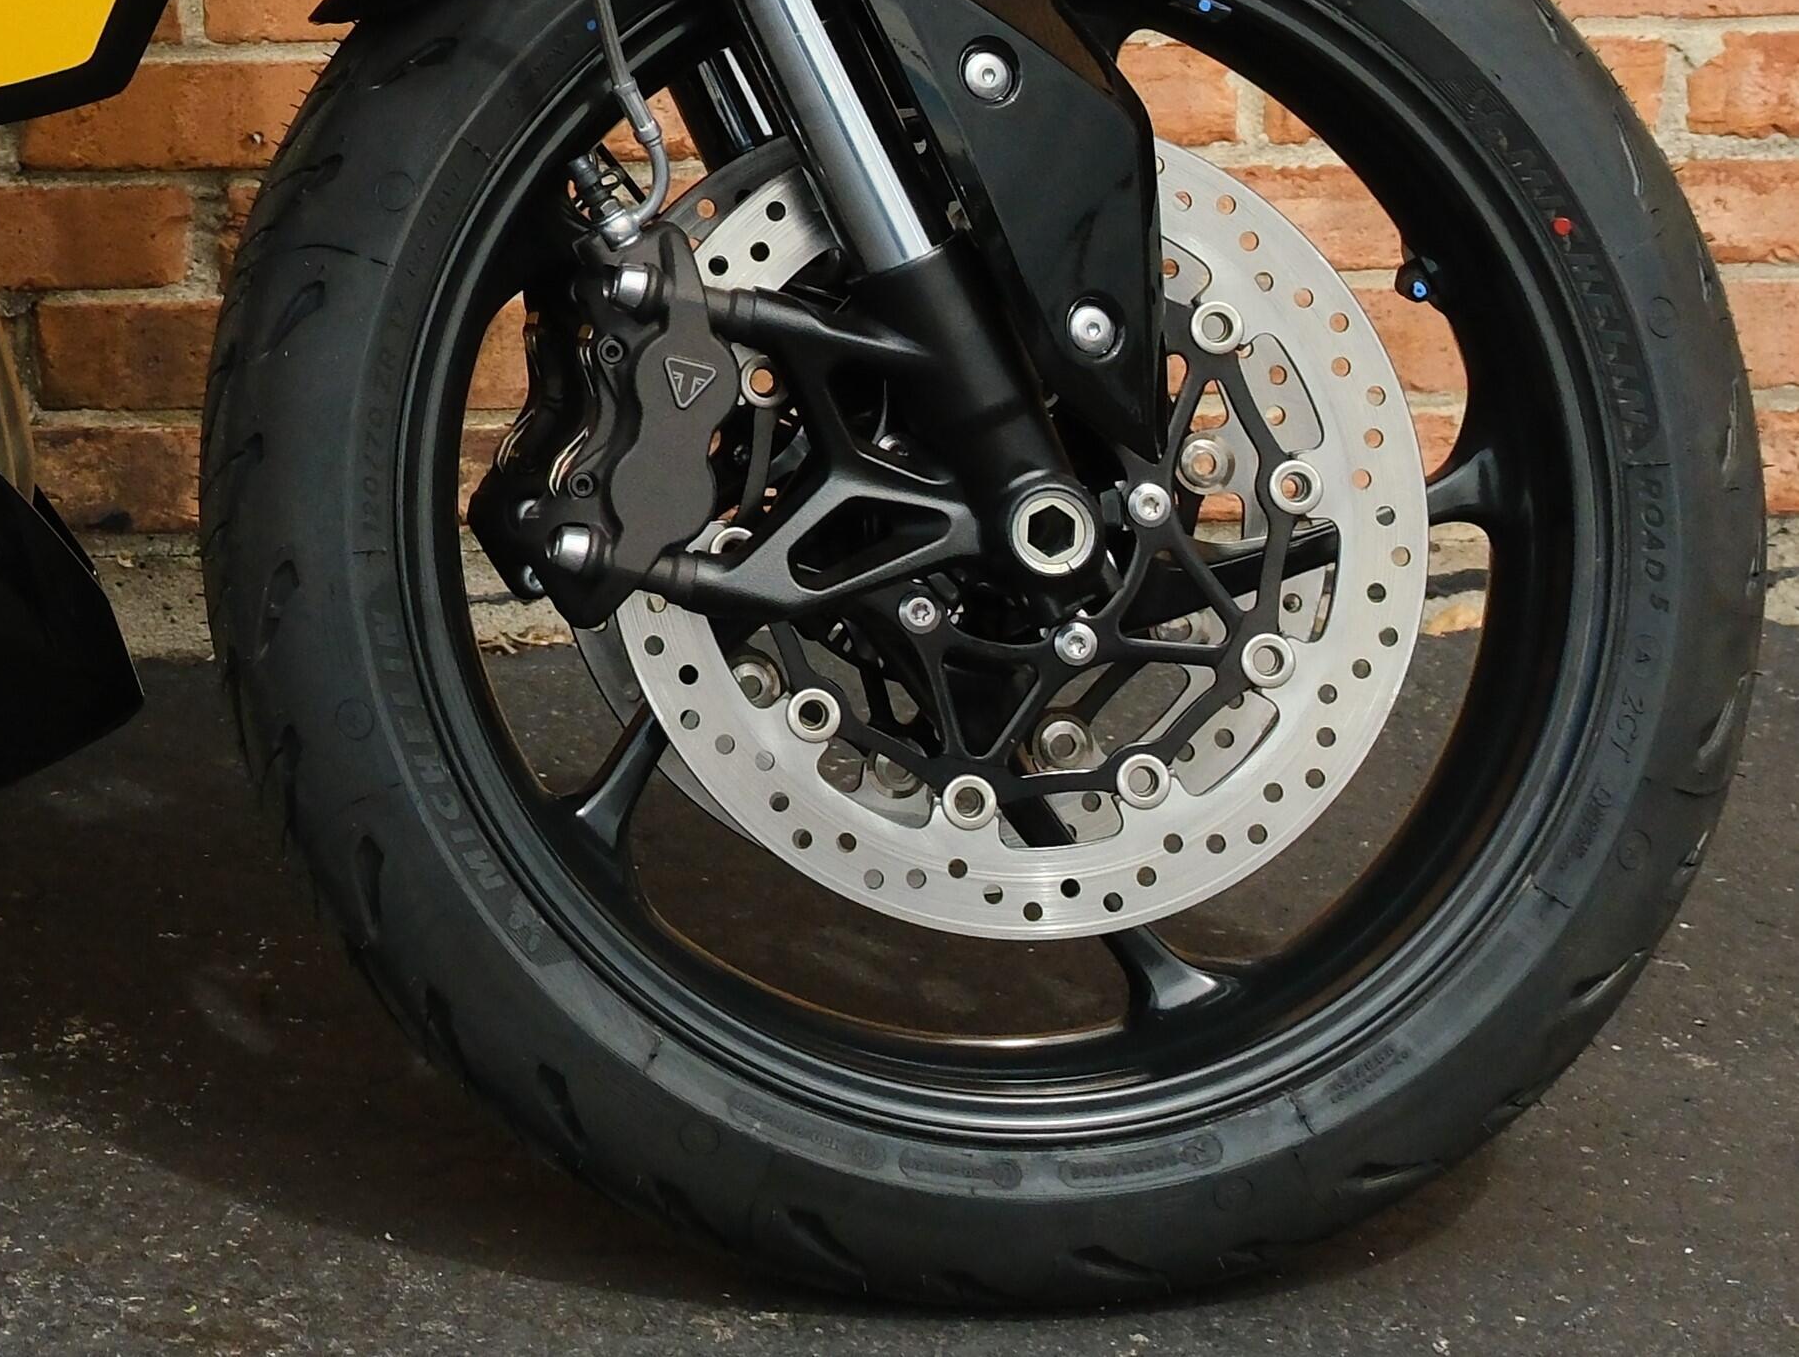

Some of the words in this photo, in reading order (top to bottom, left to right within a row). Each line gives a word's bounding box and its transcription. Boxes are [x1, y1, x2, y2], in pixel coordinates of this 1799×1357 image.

[1501, 135, 1647, 428] MICHELIN
[1641, 475, 1666, 581] ROAD
[373, 609, 509, 900] MICHELIN
